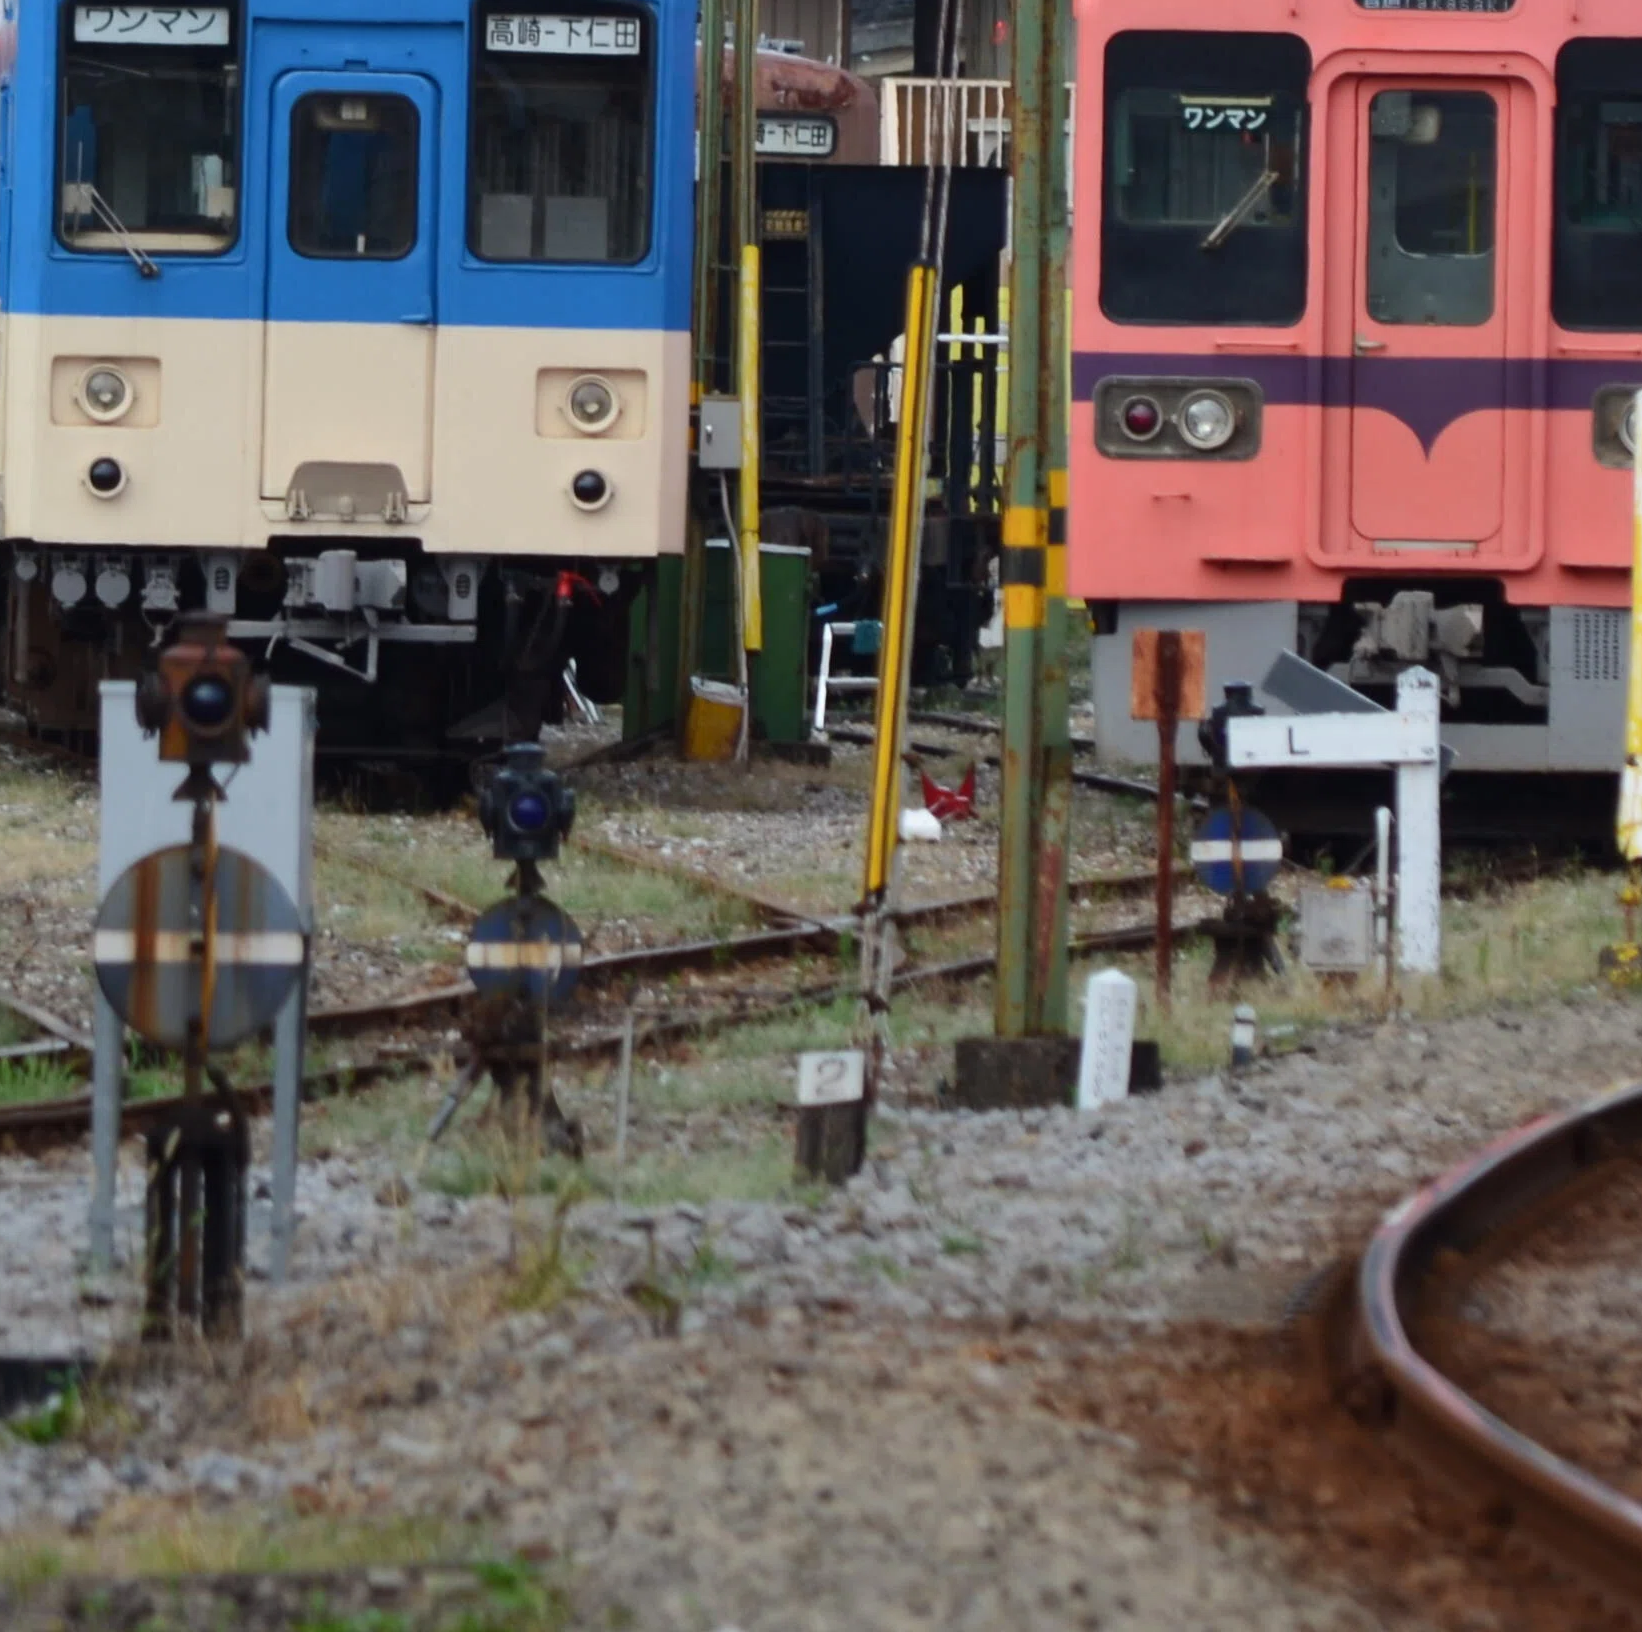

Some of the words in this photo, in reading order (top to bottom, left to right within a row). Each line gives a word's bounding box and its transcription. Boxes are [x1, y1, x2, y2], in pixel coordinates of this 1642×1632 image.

[86, 7, 216, 34] ワンマン
[1184, 107, 1267, 129] ワンマン
[1289, 725, 1310, 755] L
[815, 1058, 850, 1098] 2
